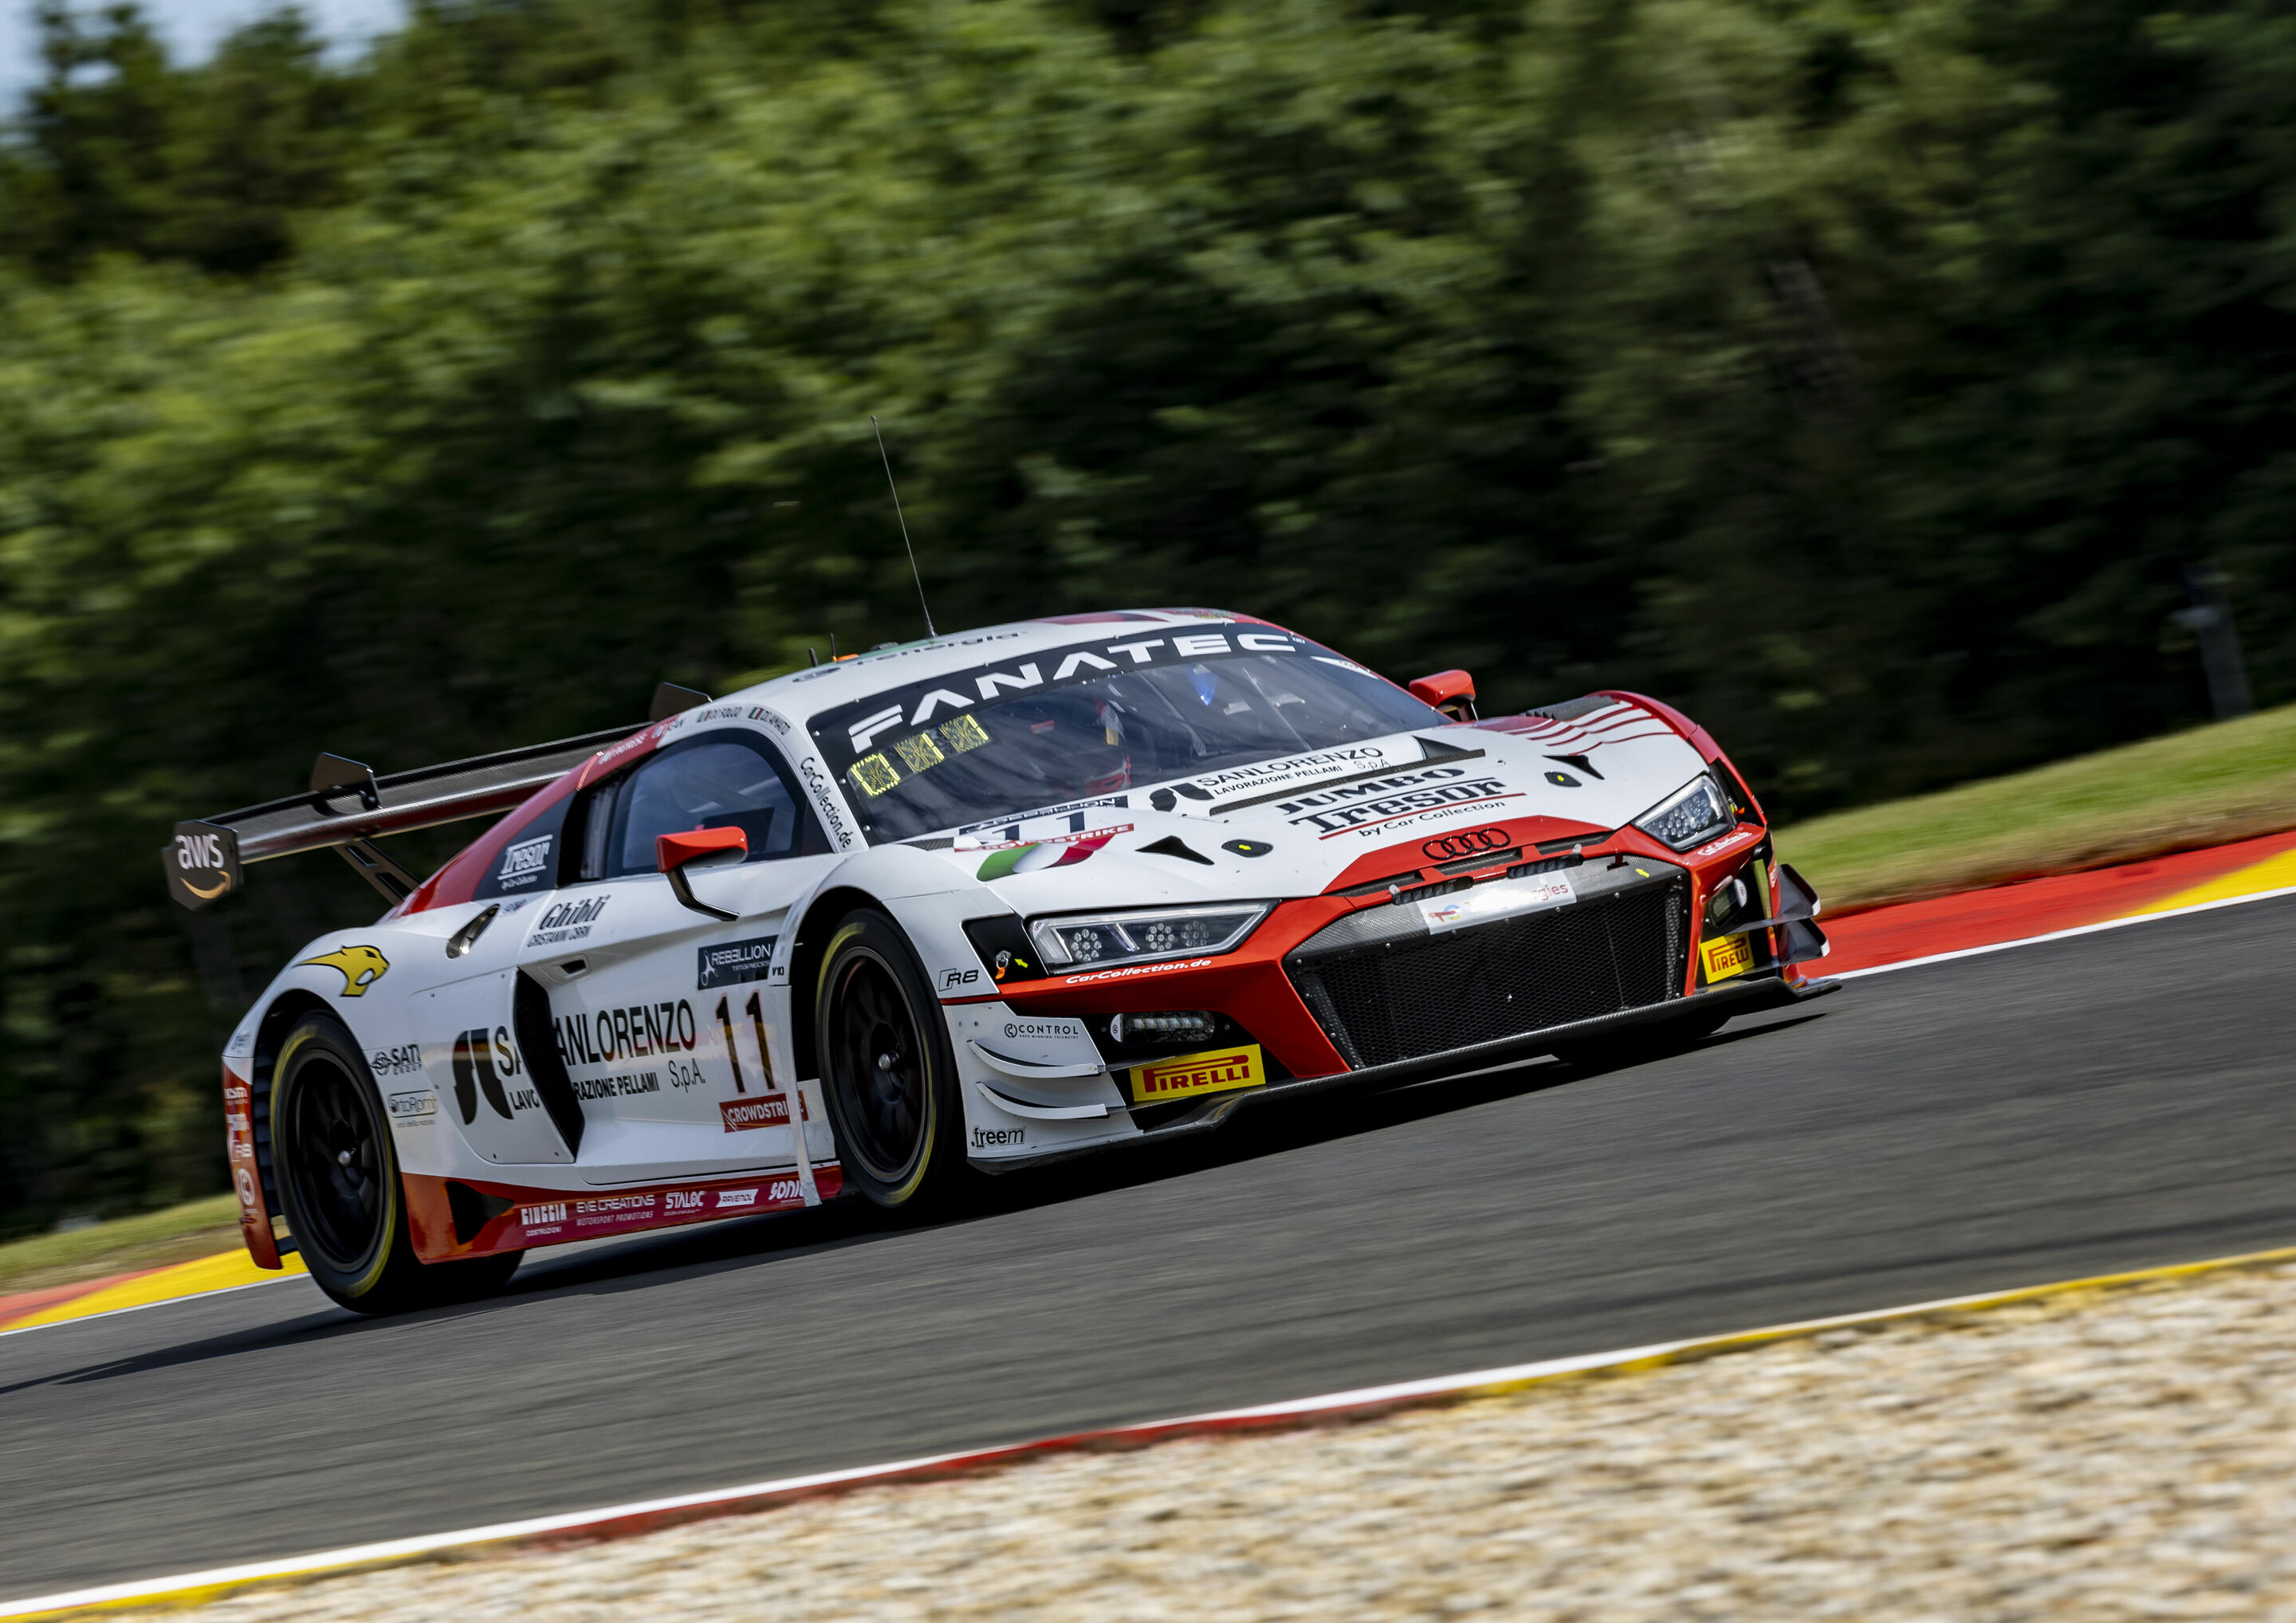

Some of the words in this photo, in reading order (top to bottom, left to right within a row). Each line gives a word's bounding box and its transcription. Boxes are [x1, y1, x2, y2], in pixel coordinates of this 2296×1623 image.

[848, 633, 1296, 754] FANATEC
[1197, 747, 1384, 786] SANLORENZO
[1214, 774, 1293, 795] LAVORAZIONE
[1295, 765, 1343, 780] PELLAMI
[800, 756, 853, 848] CarCollection.de
[1275, 768, 1465, 815] JUMBO
[1358, 827, 1381, 837] by
[1384, 818, 1414, 830] Car
[1418, 800, 1506, 821] Collection
[175, 833, 225, 869] aws
[539, 894, 611, 930] Ghibli
[711, 943, 771, 966] REBELLION
[1066, 959, 1212, 984] CarCollection.de
[1708, 937, 1749, 973] PIRELLI
[946, 969, 979, 988] R8
[715, 992, 779, 1095] 11
[1019, 1024, 1078, 1035] CONTROL
[616, 1071, 661, 1096] PELLAMI
[668, 1058, 706, 1094] S.p.A.
[1142, 1055, 1250, 1094] PIRELLI
[599, 1194, 655, 1211] CREATIONS
[665, 1191, 706, 1209] STALOC
